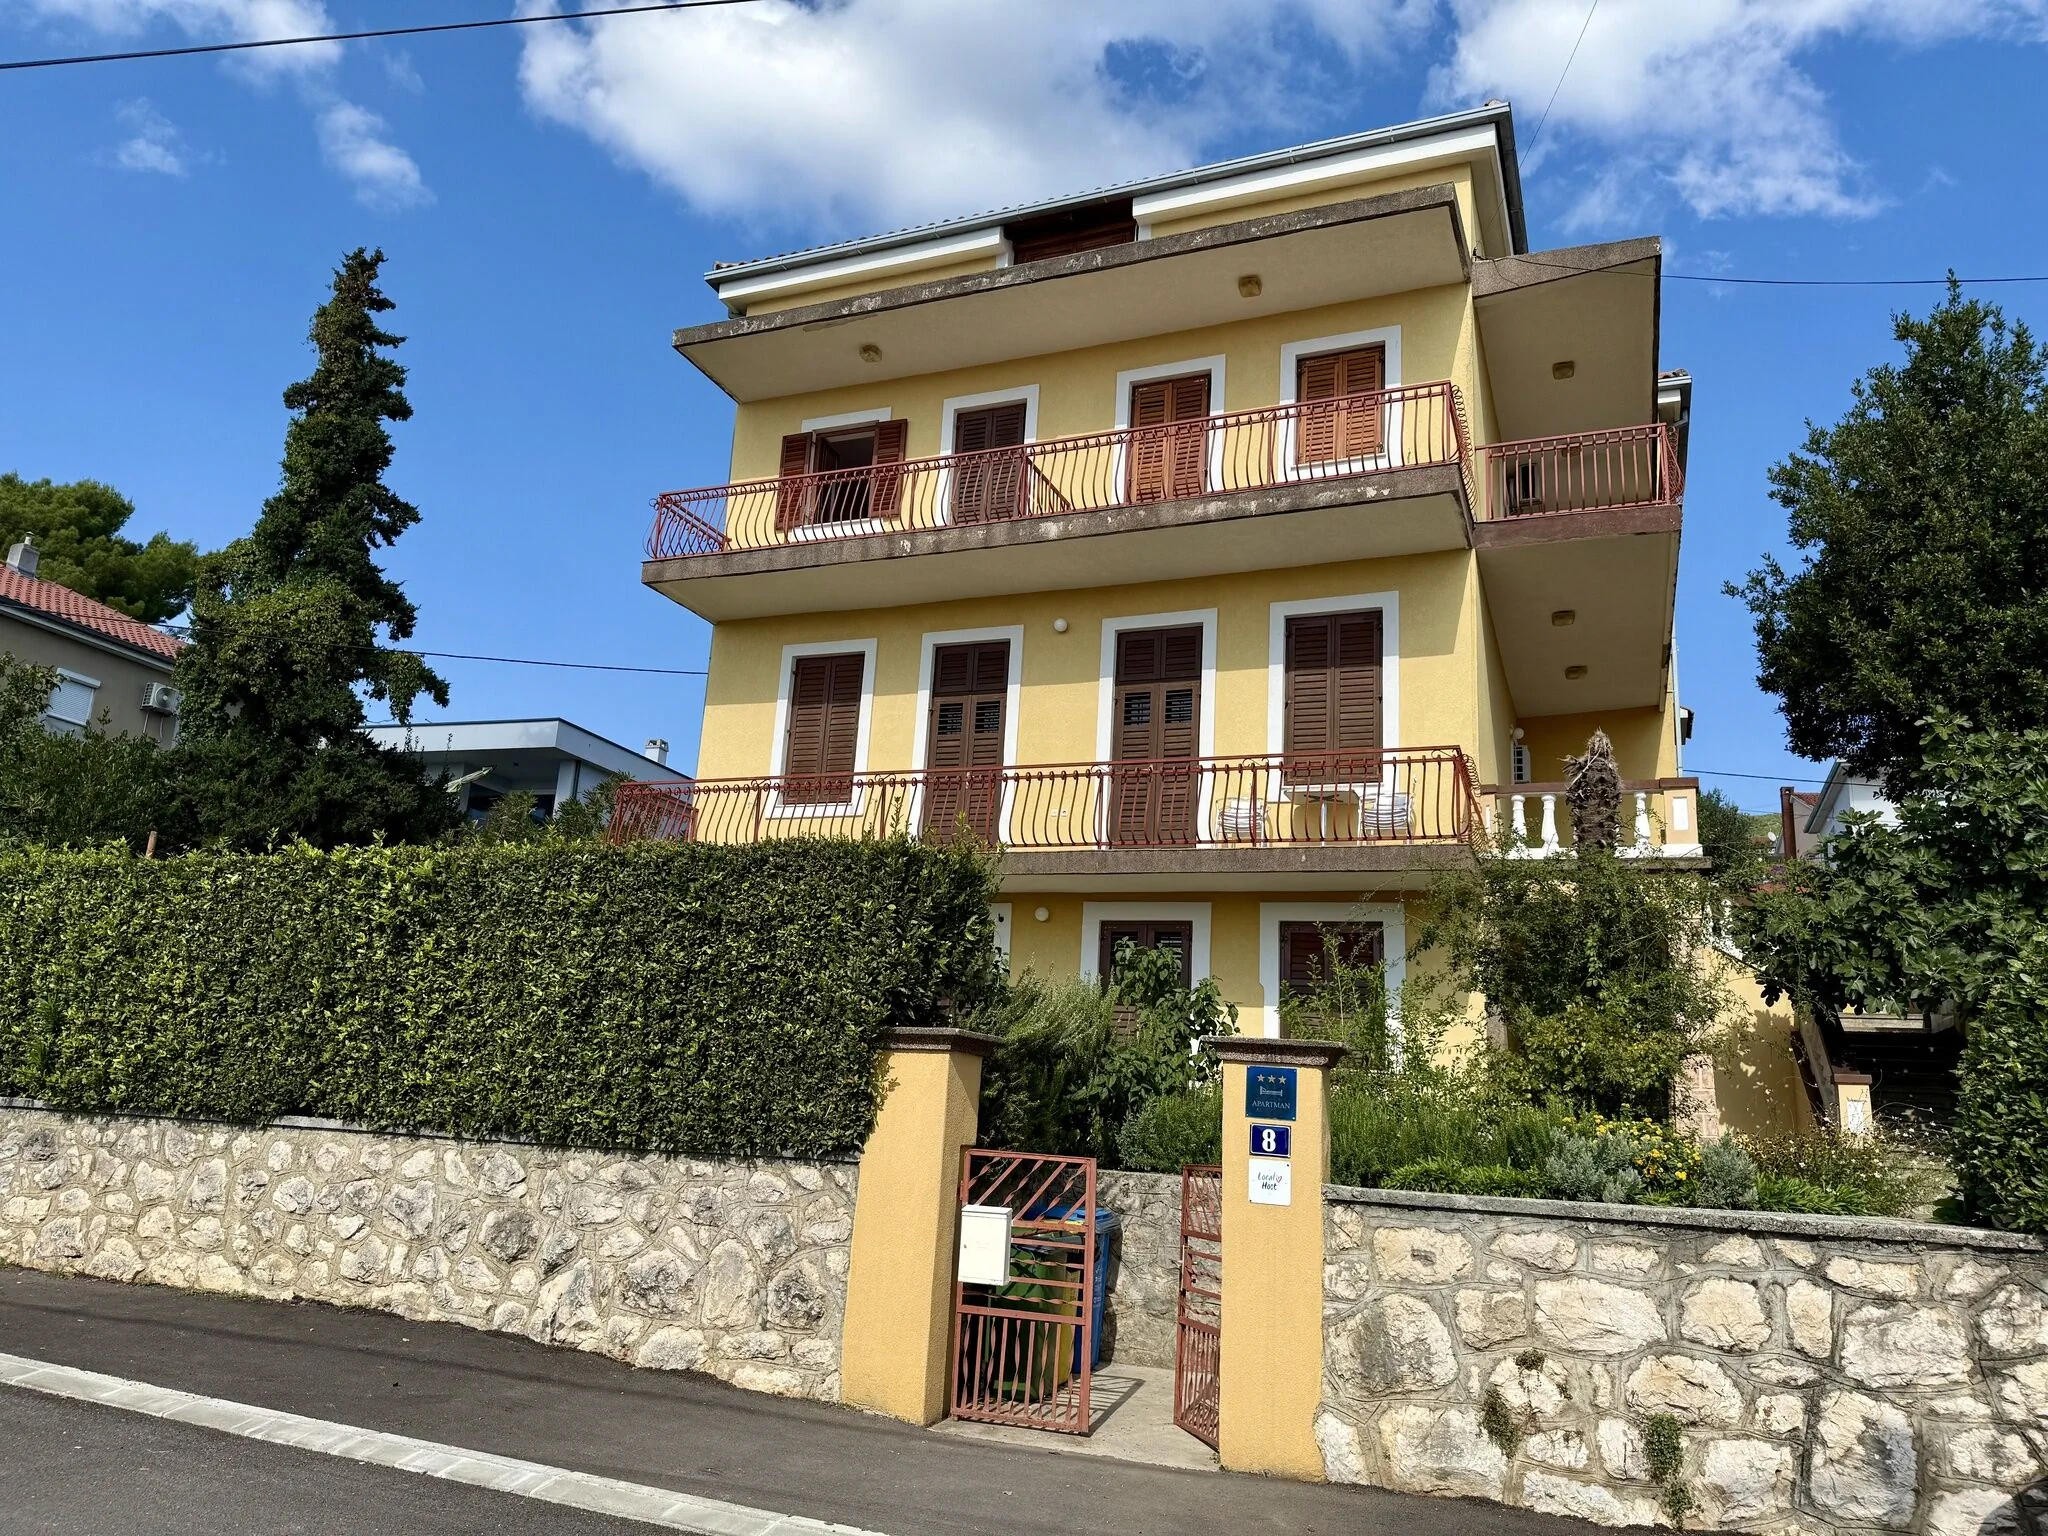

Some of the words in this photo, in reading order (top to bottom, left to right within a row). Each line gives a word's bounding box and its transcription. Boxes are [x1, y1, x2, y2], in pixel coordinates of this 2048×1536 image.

[1252, 1100, 1290, 1109] APARTMAN
[1262, 1129, 1276, 1152] 8
[1258, 1172, 1276, 1181] Local
[1261, 1181, 1277, 1190] Host
